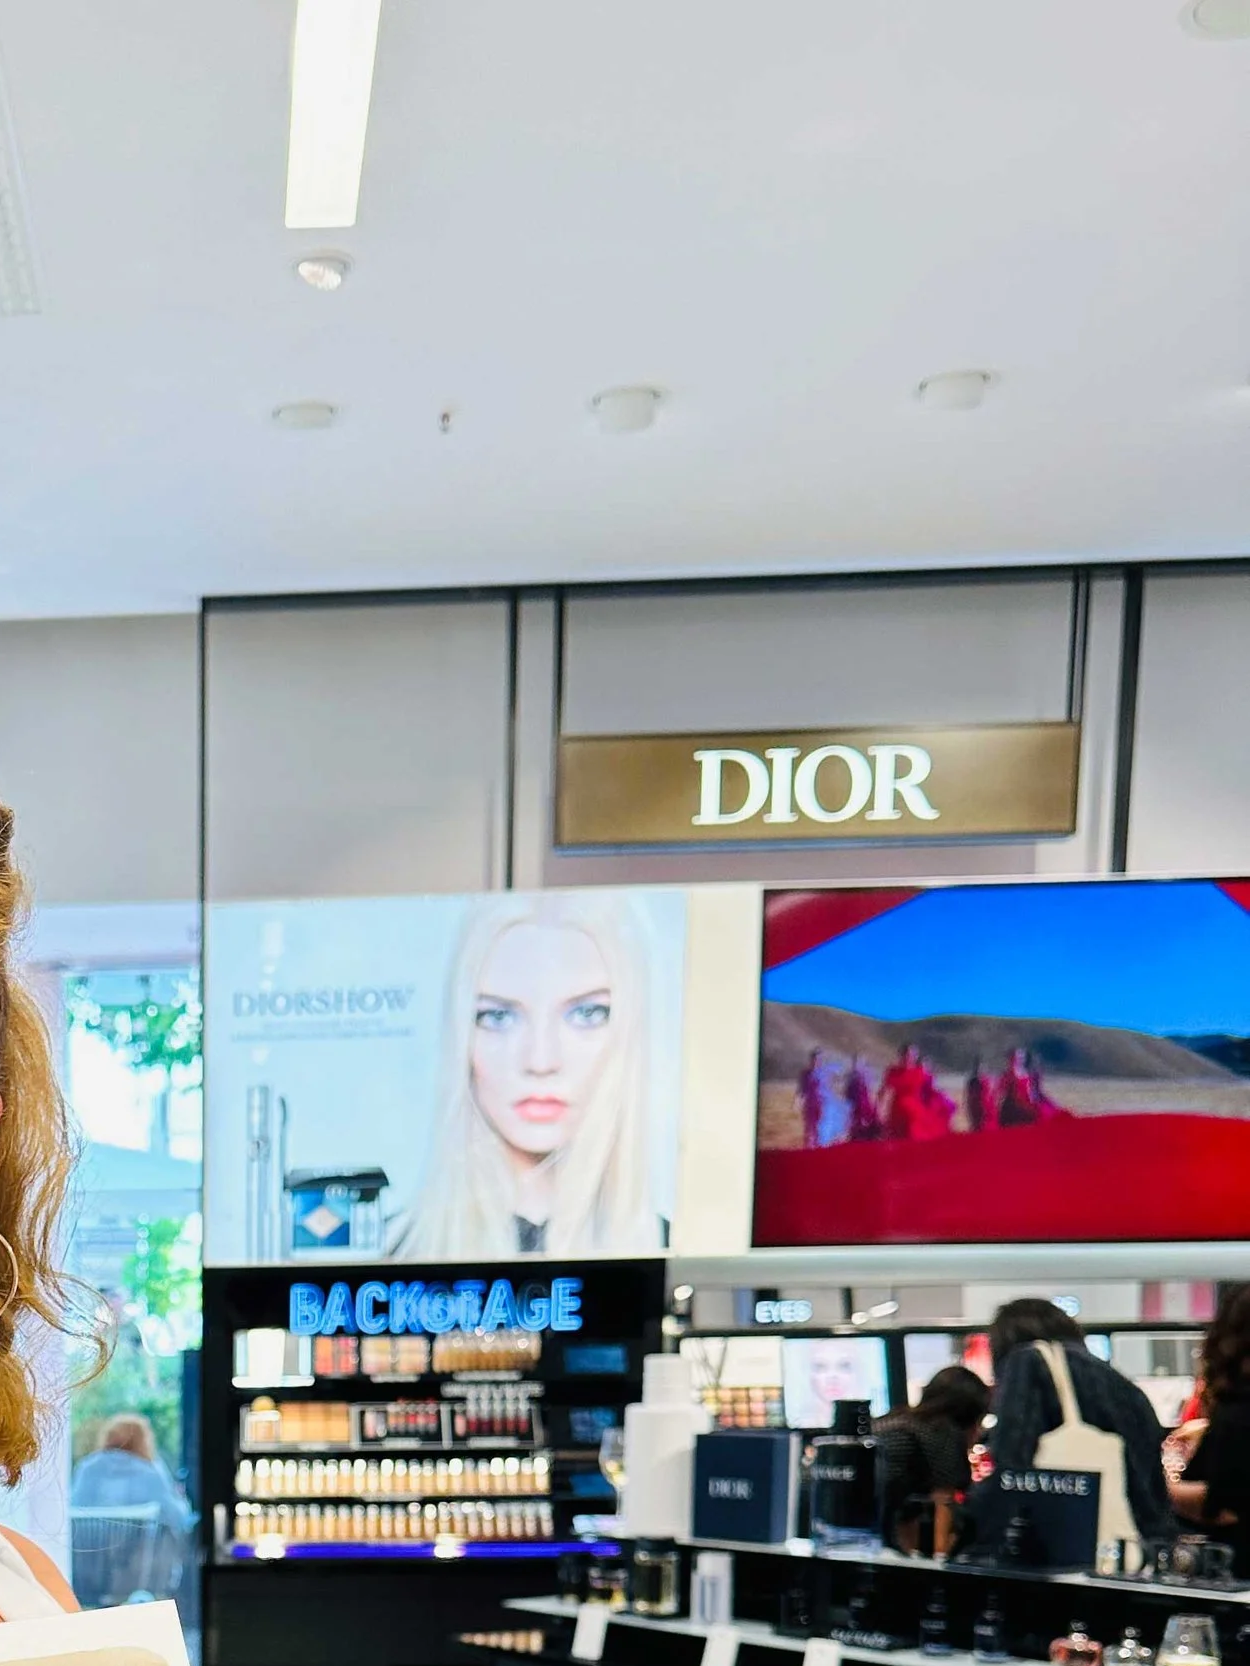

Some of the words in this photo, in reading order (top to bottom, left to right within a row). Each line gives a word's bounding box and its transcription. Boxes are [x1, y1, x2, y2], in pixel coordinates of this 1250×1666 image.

[691, 744, 940, 825] DIOR
[232, 983, 414, 1018] DIORSHOW
[290, 1277, 583, 1335] BACKSTAGE
[755, 1300, 813, 1323] EYES
